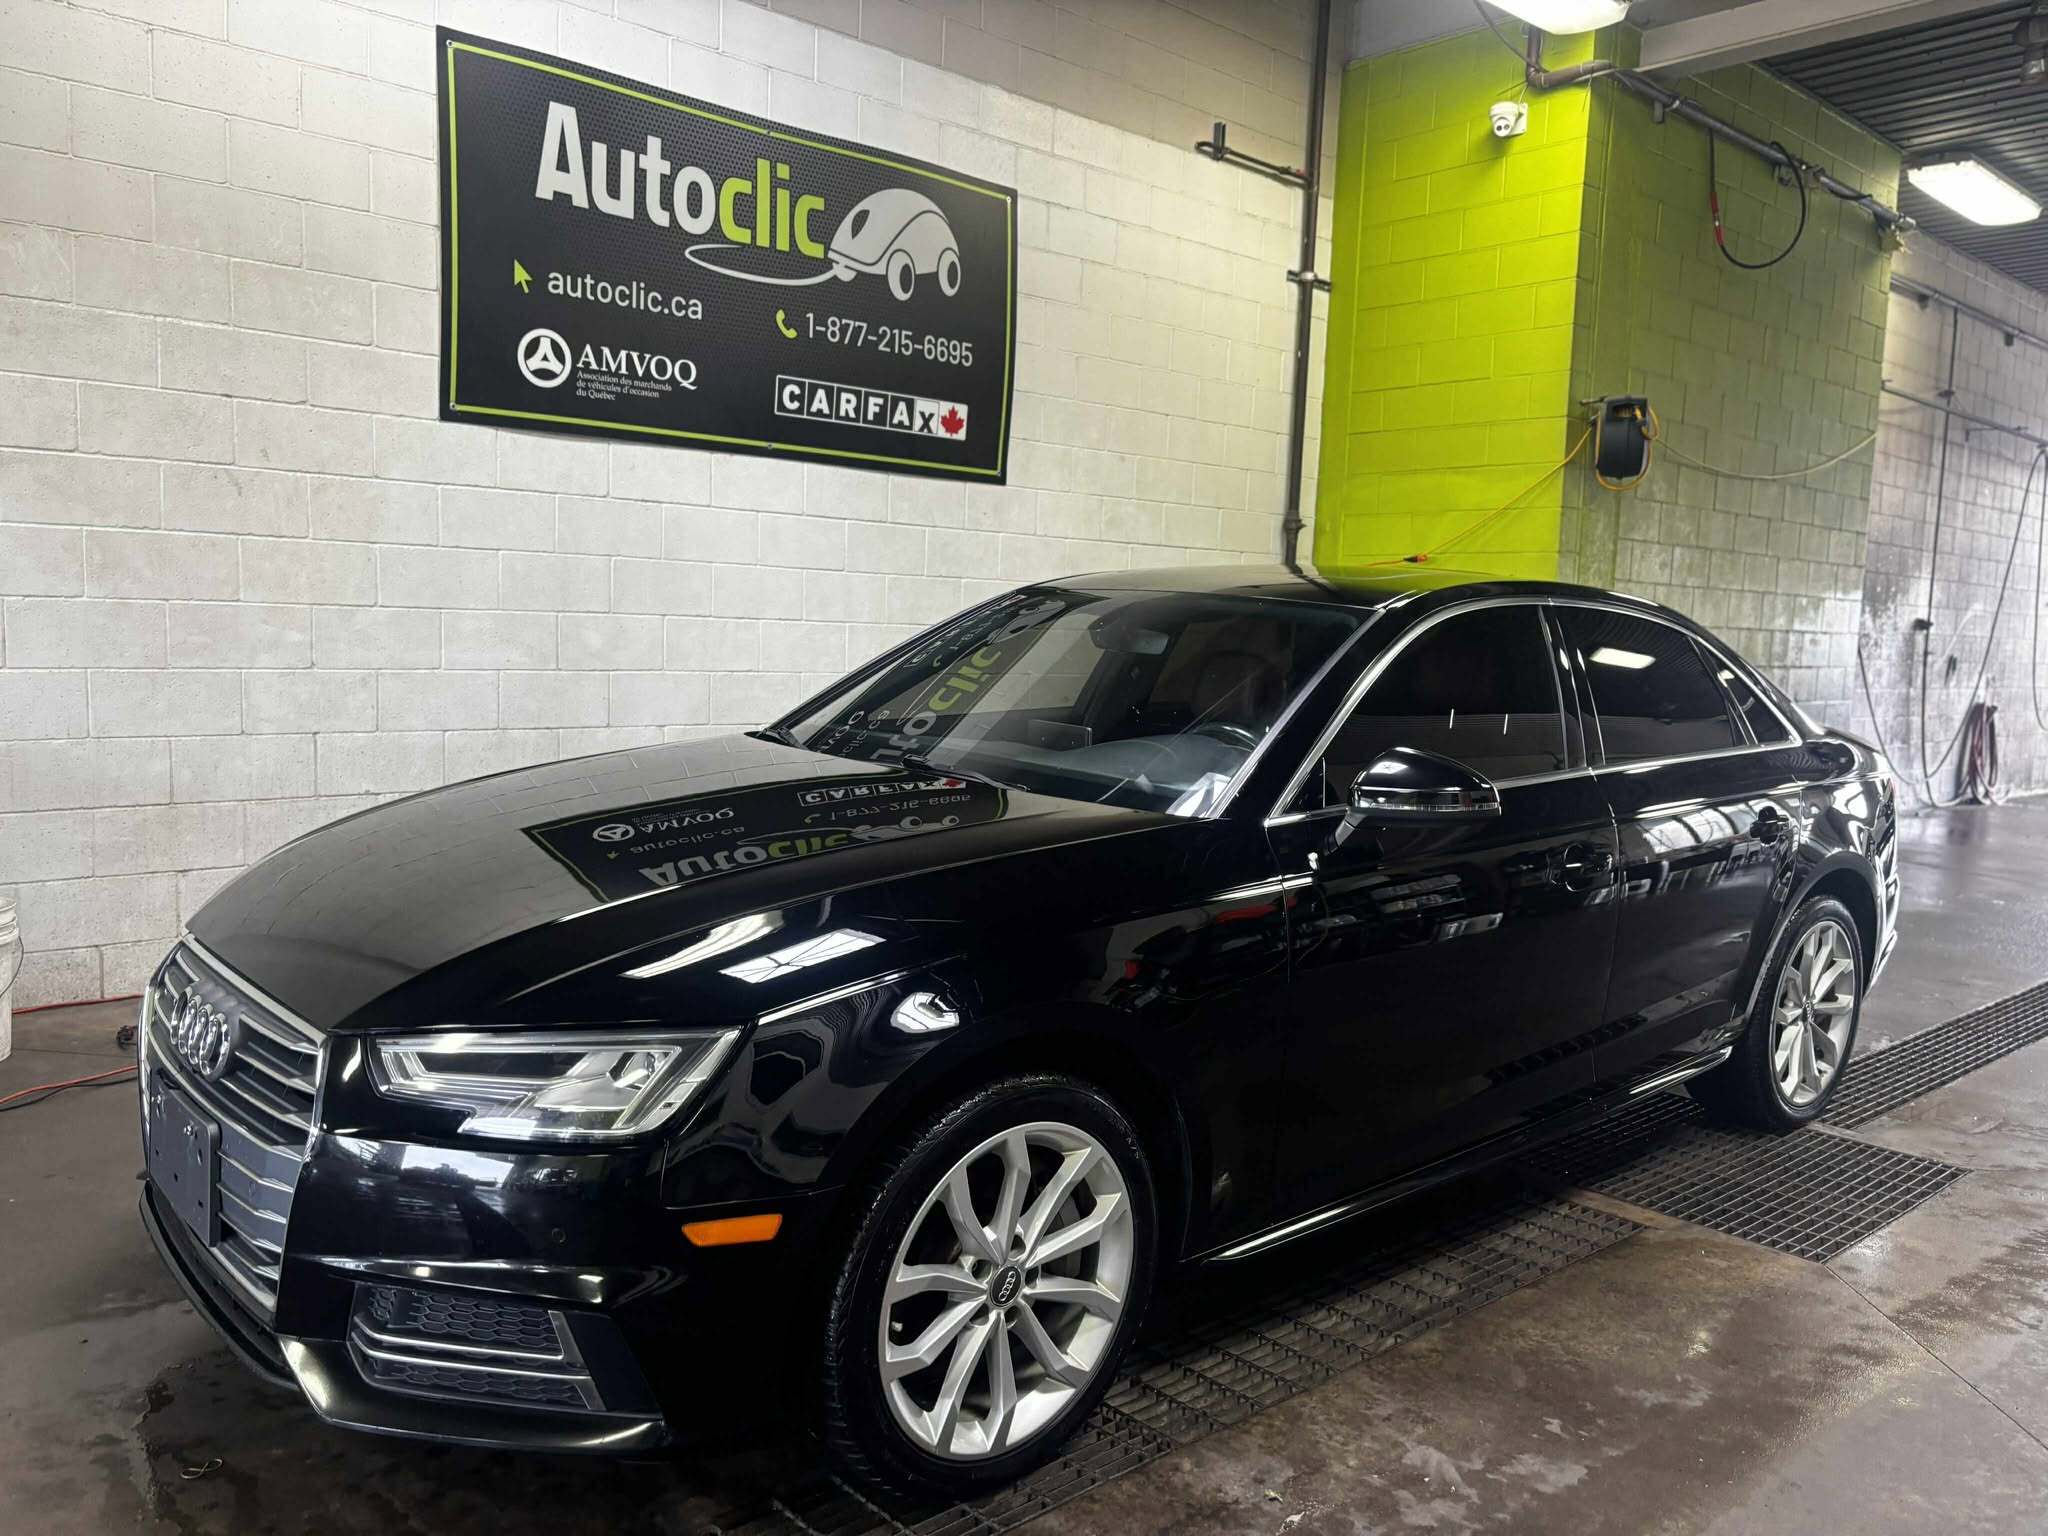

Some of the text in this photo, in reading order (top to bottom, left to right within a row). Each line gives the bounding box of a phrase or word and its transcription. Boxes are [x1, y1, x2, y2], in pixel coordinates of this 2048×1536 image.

[535, 101, 825, 259] Autoclic
[547, 272, 702, 320] autoclic.ca
[805, 312, 973, 367] 1-877-215-6695
[576, 344, 698, 390] AMVOQ
[576, 379, 586, 388] de
[588, 381, 621, 393] véhicules
[577, 370, 673, 392] Association des marchands
[576, 388, 616, 401] du Québec
[782, 384, 935, 434] CARFAX
